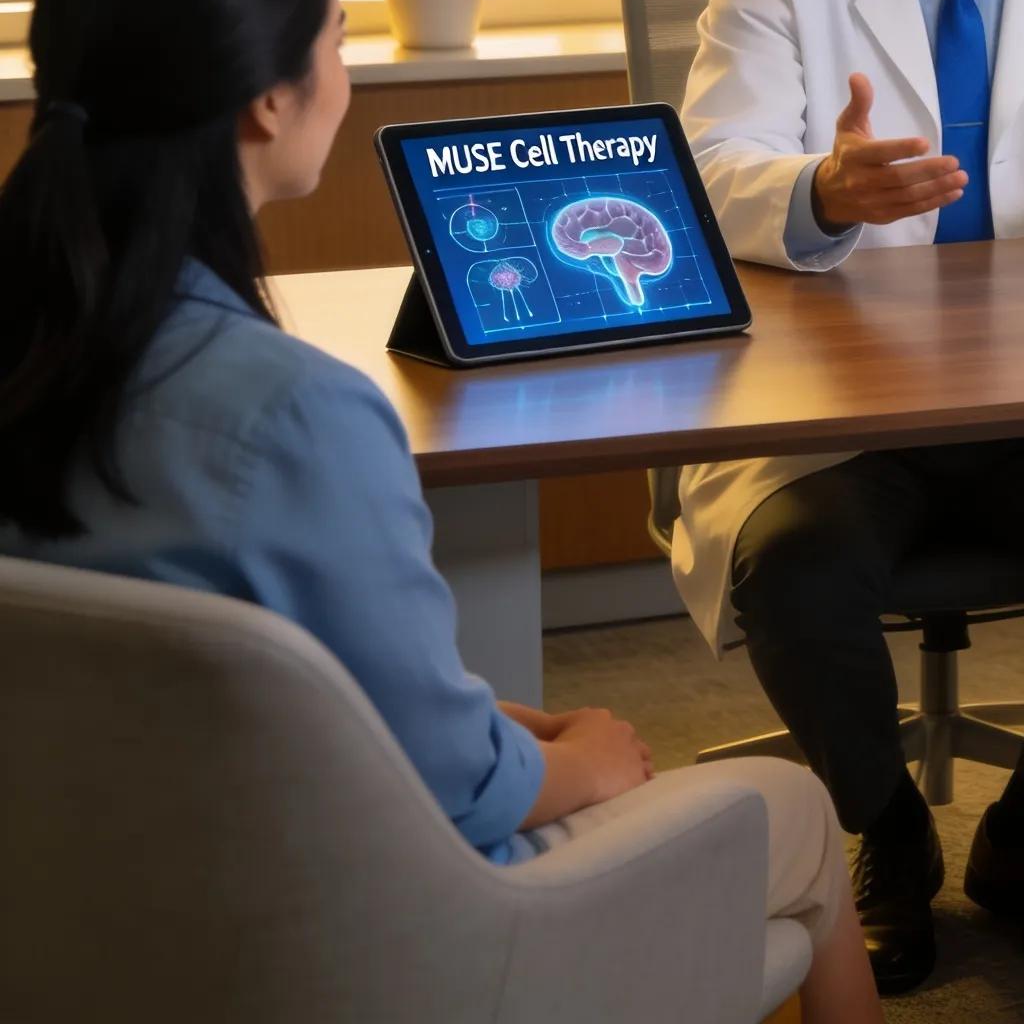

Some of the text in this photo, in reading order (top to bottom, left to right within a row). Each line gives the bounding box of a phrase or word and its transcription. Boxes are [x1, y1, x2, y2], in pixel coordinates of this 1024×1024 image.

[426, 131, 657, 178] MUSE Cell Therapy
